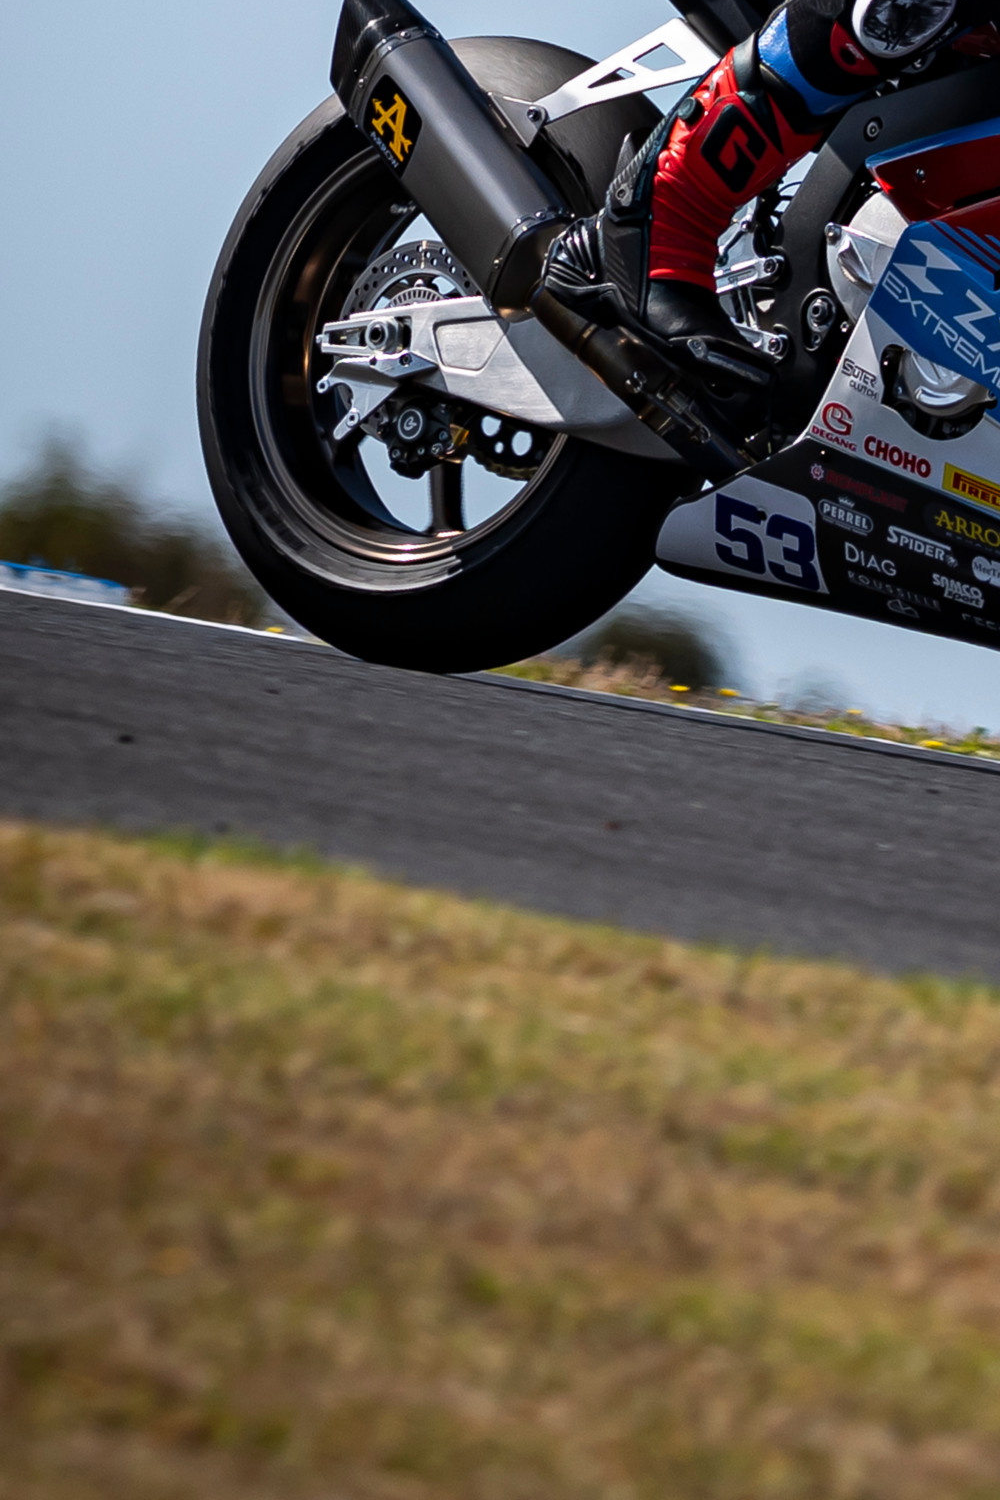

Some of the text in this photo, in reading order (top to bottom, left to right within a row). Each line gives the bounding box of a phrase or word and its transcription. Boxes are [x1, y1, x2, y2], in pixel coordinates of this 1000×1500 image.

[841, 358, 877, 388] SUTER
[850, 380, 877, 399] CLUTCH
[811, 425, 857, 452] DEGANG
[864, 435, 931, 478] CHOHO
[823, 503, 869, 530] PERREL
[715, 492, 820, 592] 53
[886, 524, 952, 562] SPIDER
[844, 541, 897, 577] DIAG
